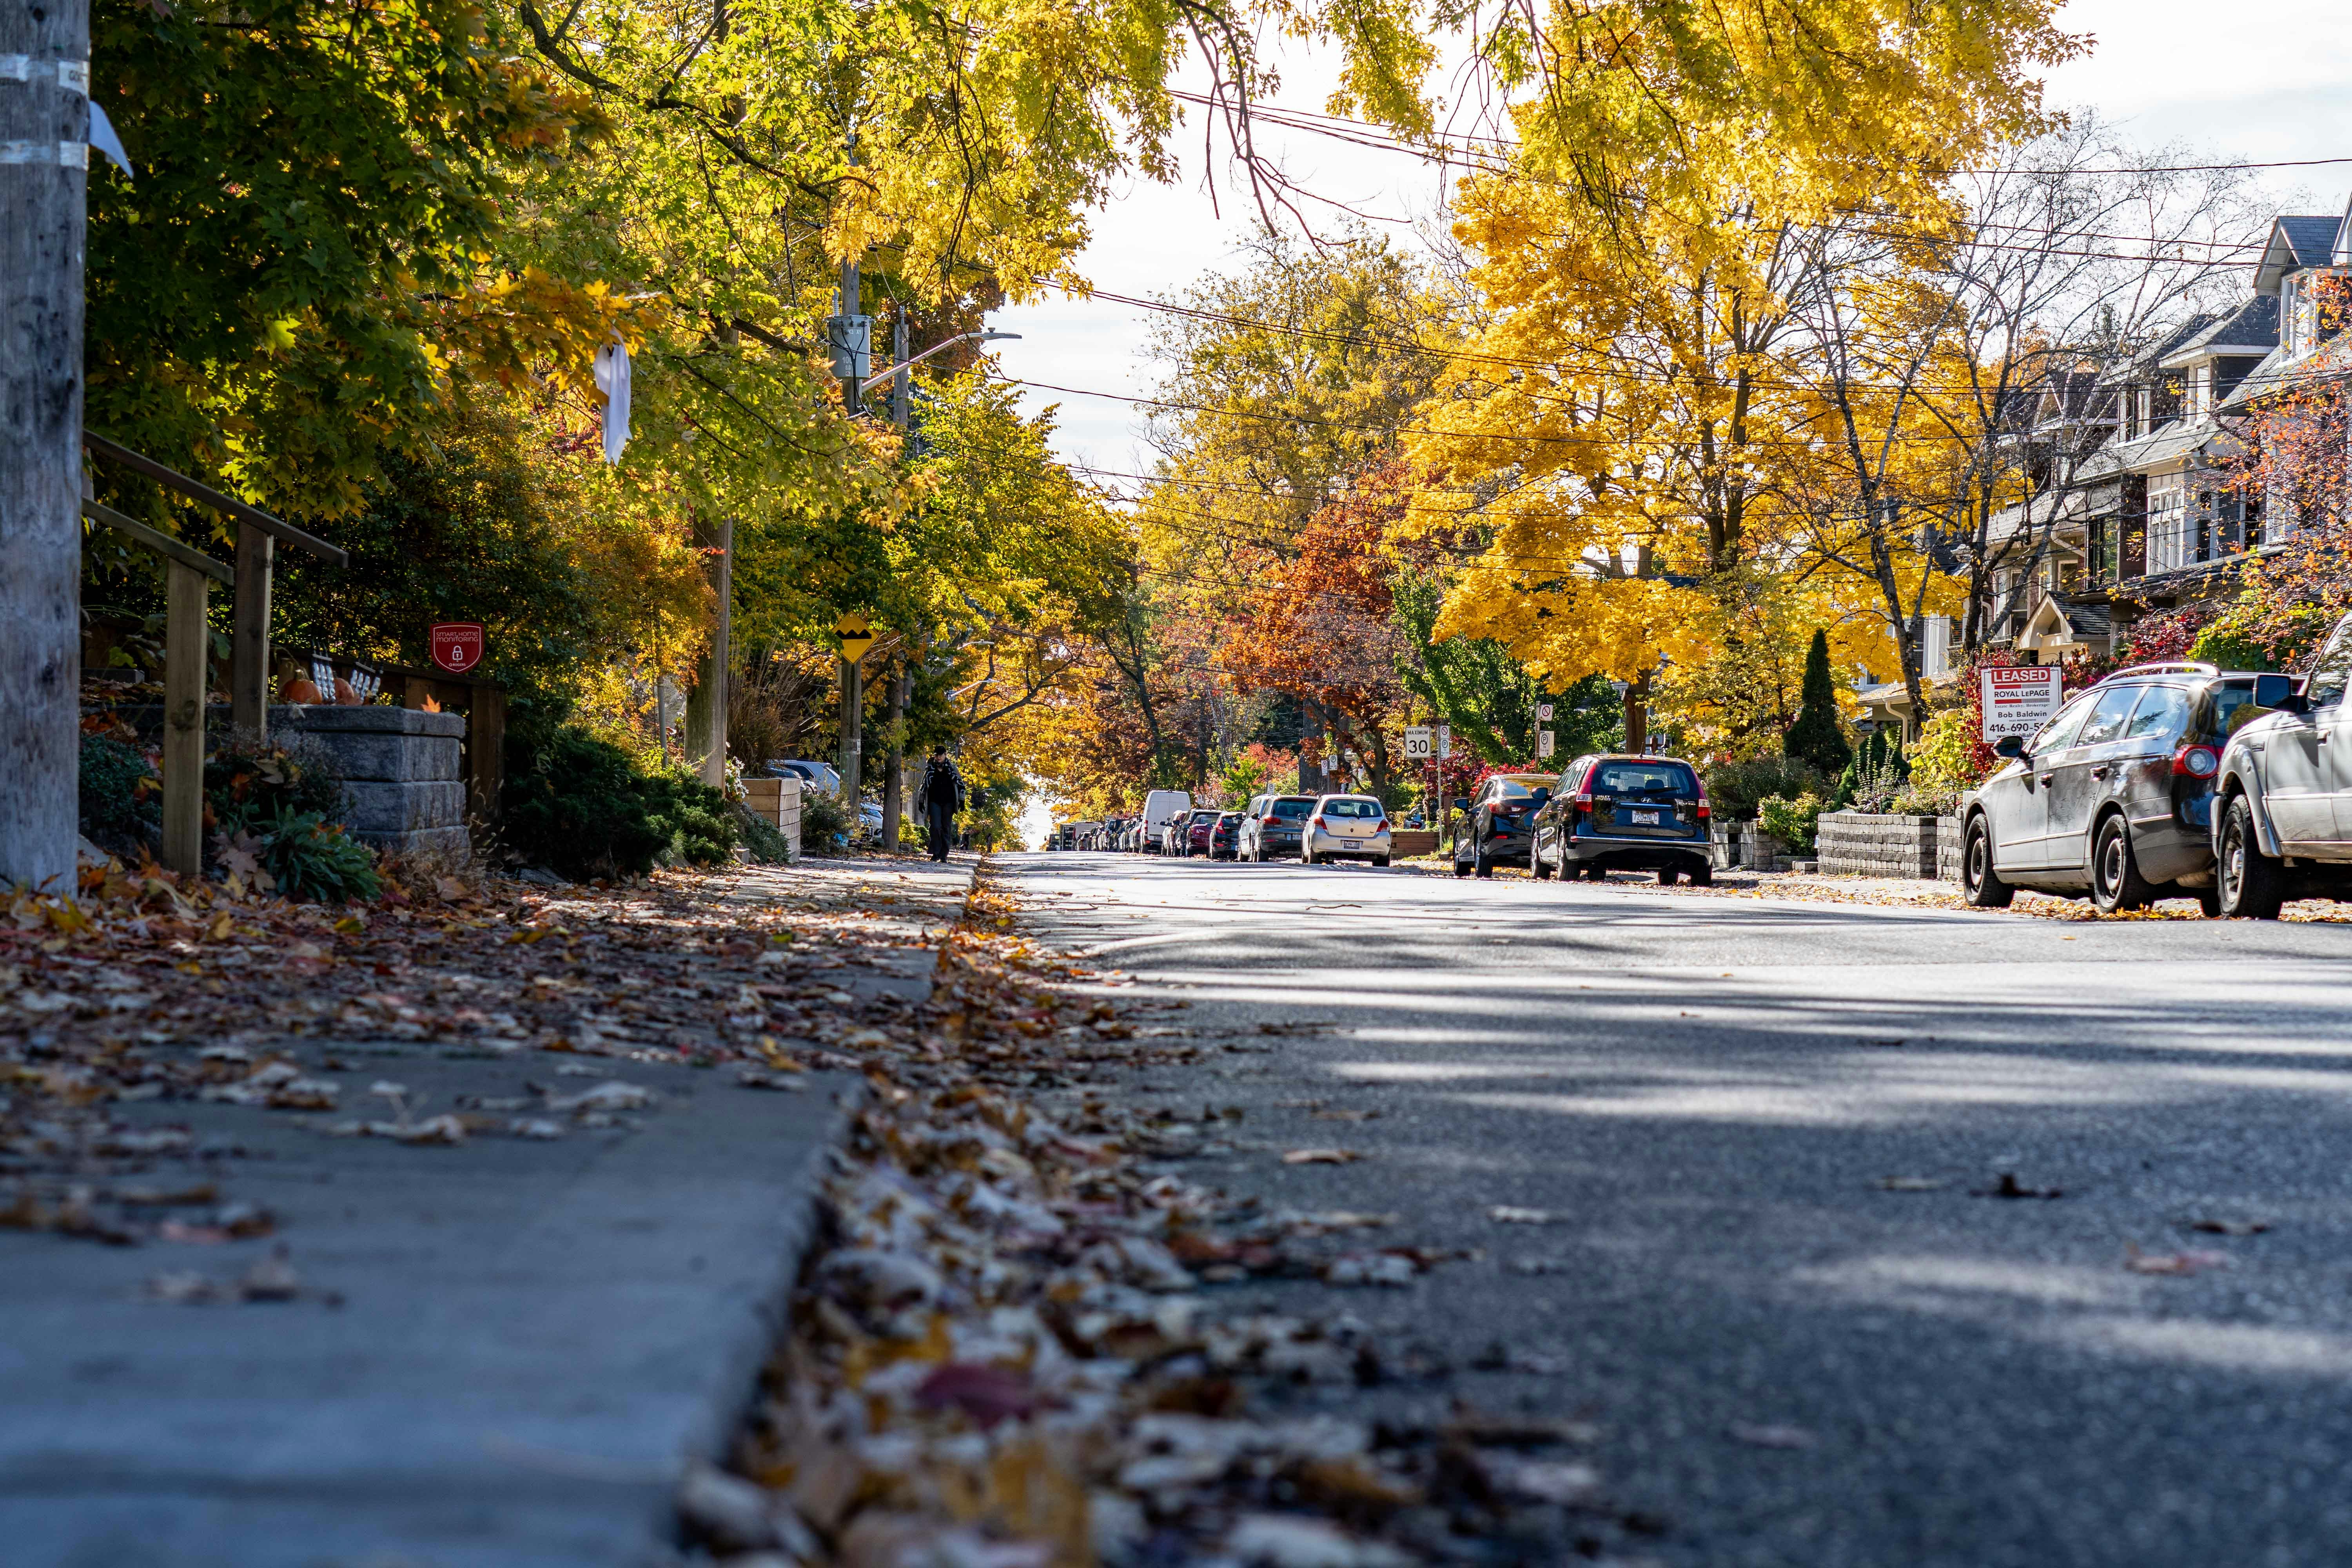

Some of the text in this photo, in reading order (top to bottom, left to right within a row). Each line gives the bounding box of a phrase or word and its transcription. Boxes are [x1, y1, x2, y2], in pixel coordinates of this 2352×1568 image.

[1993, 670, 2048, 682] LEASED
[1989, 723, 2044, 732] 416-690-5
[1408, 740, 1428, 753] 30
